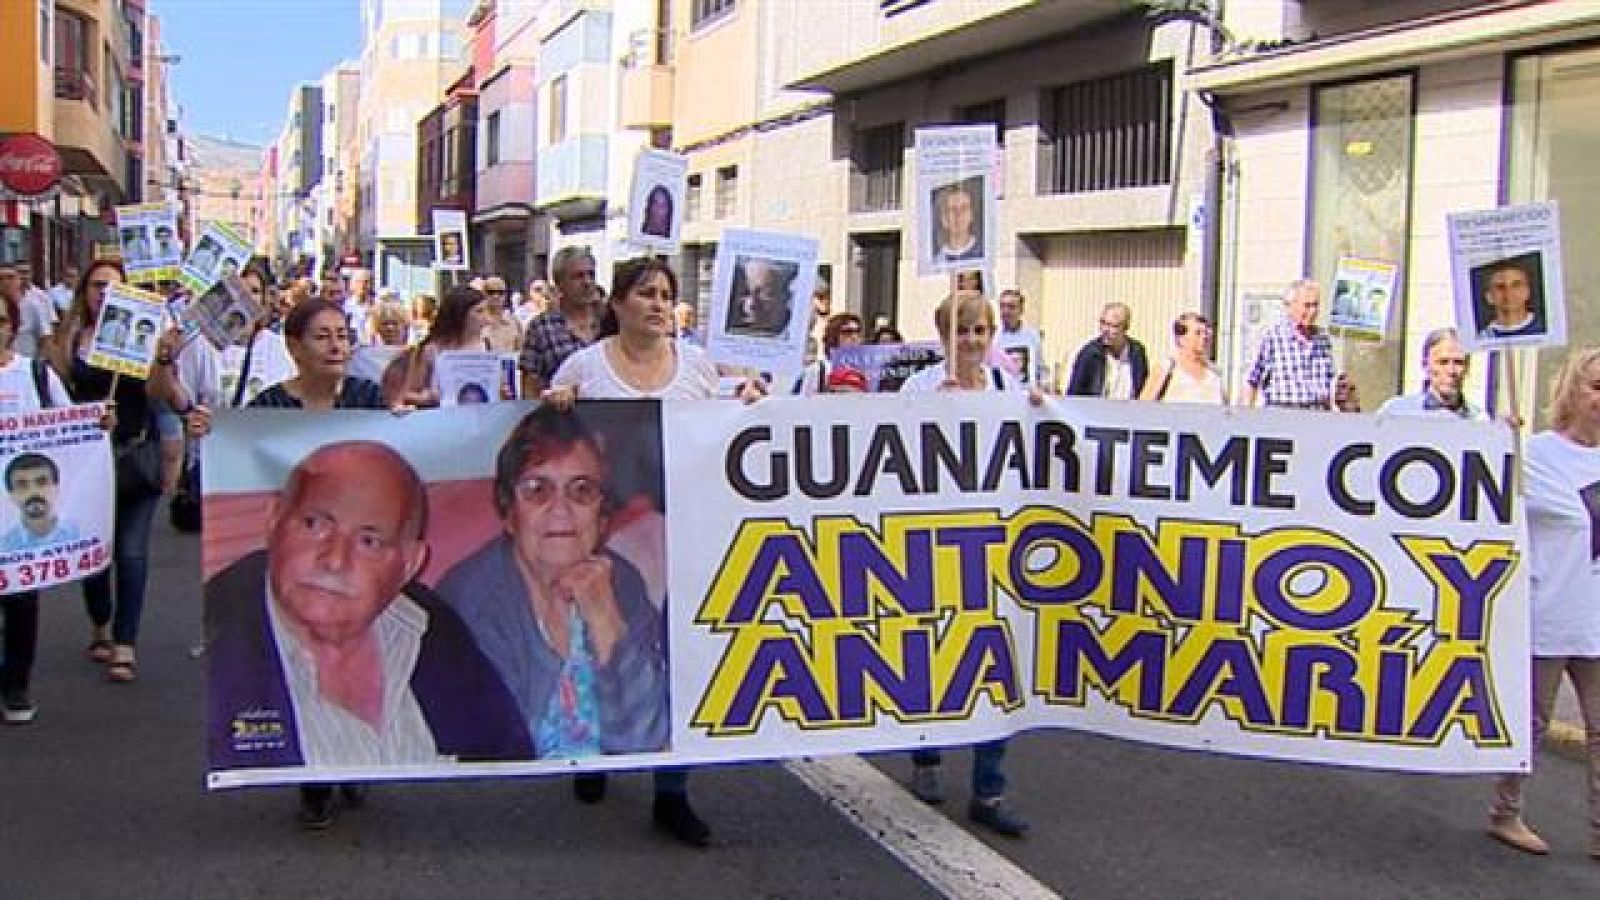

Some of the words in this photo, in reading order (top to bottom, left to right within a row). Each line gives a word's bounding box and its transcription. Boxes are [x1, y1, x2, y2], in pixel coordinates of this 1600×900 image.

[23, 405, 102, 428] NAVARRO
[725, 420, 1295, 509] GUANARTEME
[1326, 442, 1513, 524] CON
[18, 559, 70, 586] 378
[41, 537, 101, 558] AYUDA
[700, 508, 1384, 632] ANTONIO
[1405, 540, 1516, 642] Y
[698, 616, 1024, 734] ANA
[1040, 612, 1510, 746] MARÍA
